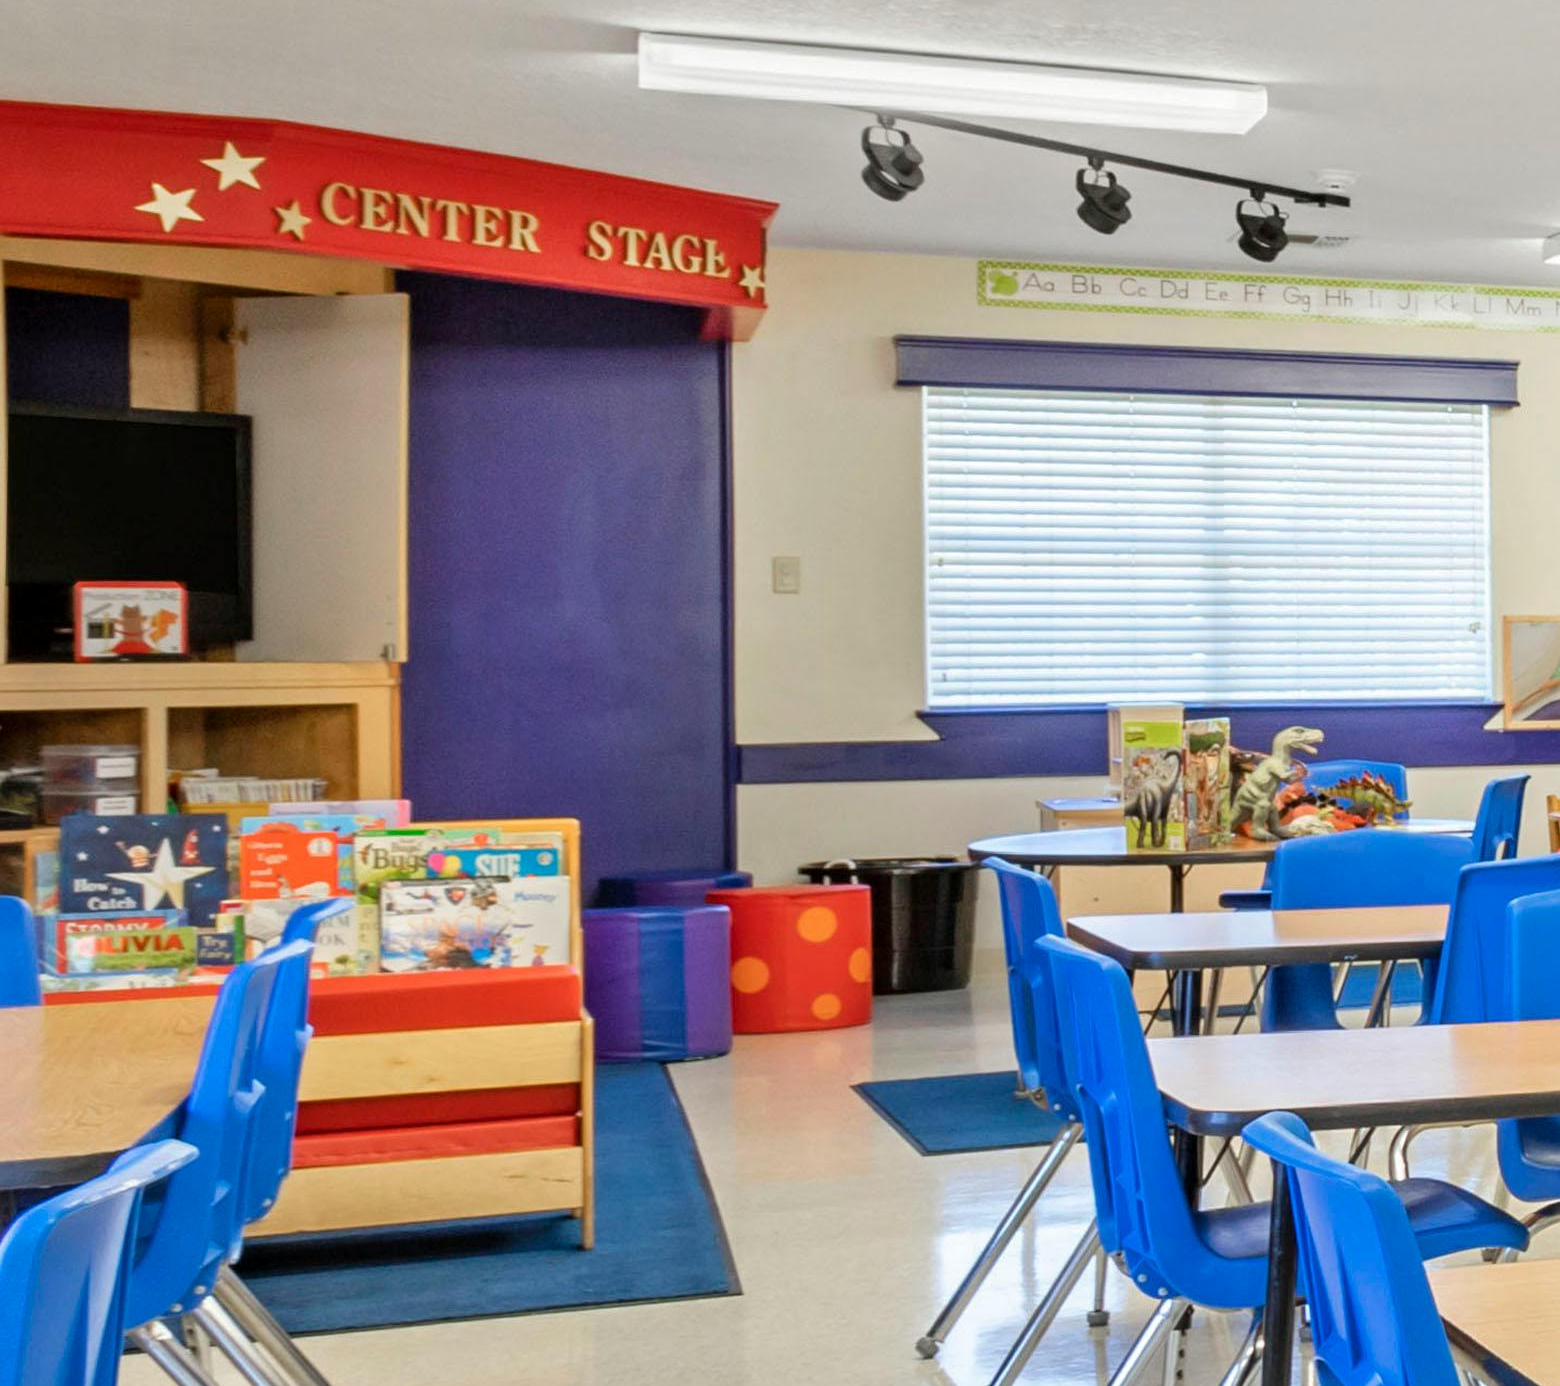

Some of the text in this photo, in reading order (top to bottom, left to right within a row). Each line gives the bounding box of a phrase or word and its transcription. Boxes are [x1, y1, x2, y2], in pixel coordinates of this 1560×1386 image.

[320, 180, 731, 279] CENTER STAGE
[1022, 272, 1055, 295] Aa
[1071, 274, 1103, 296] Bb
[1160, 279, 1190, 301] Dd
[1243, 283, 1266, 304] Ff
[1283, 286, 1311, 313] Gg
[73, 878, 110, 894] How
[87, 896, 137, 911] Catch
